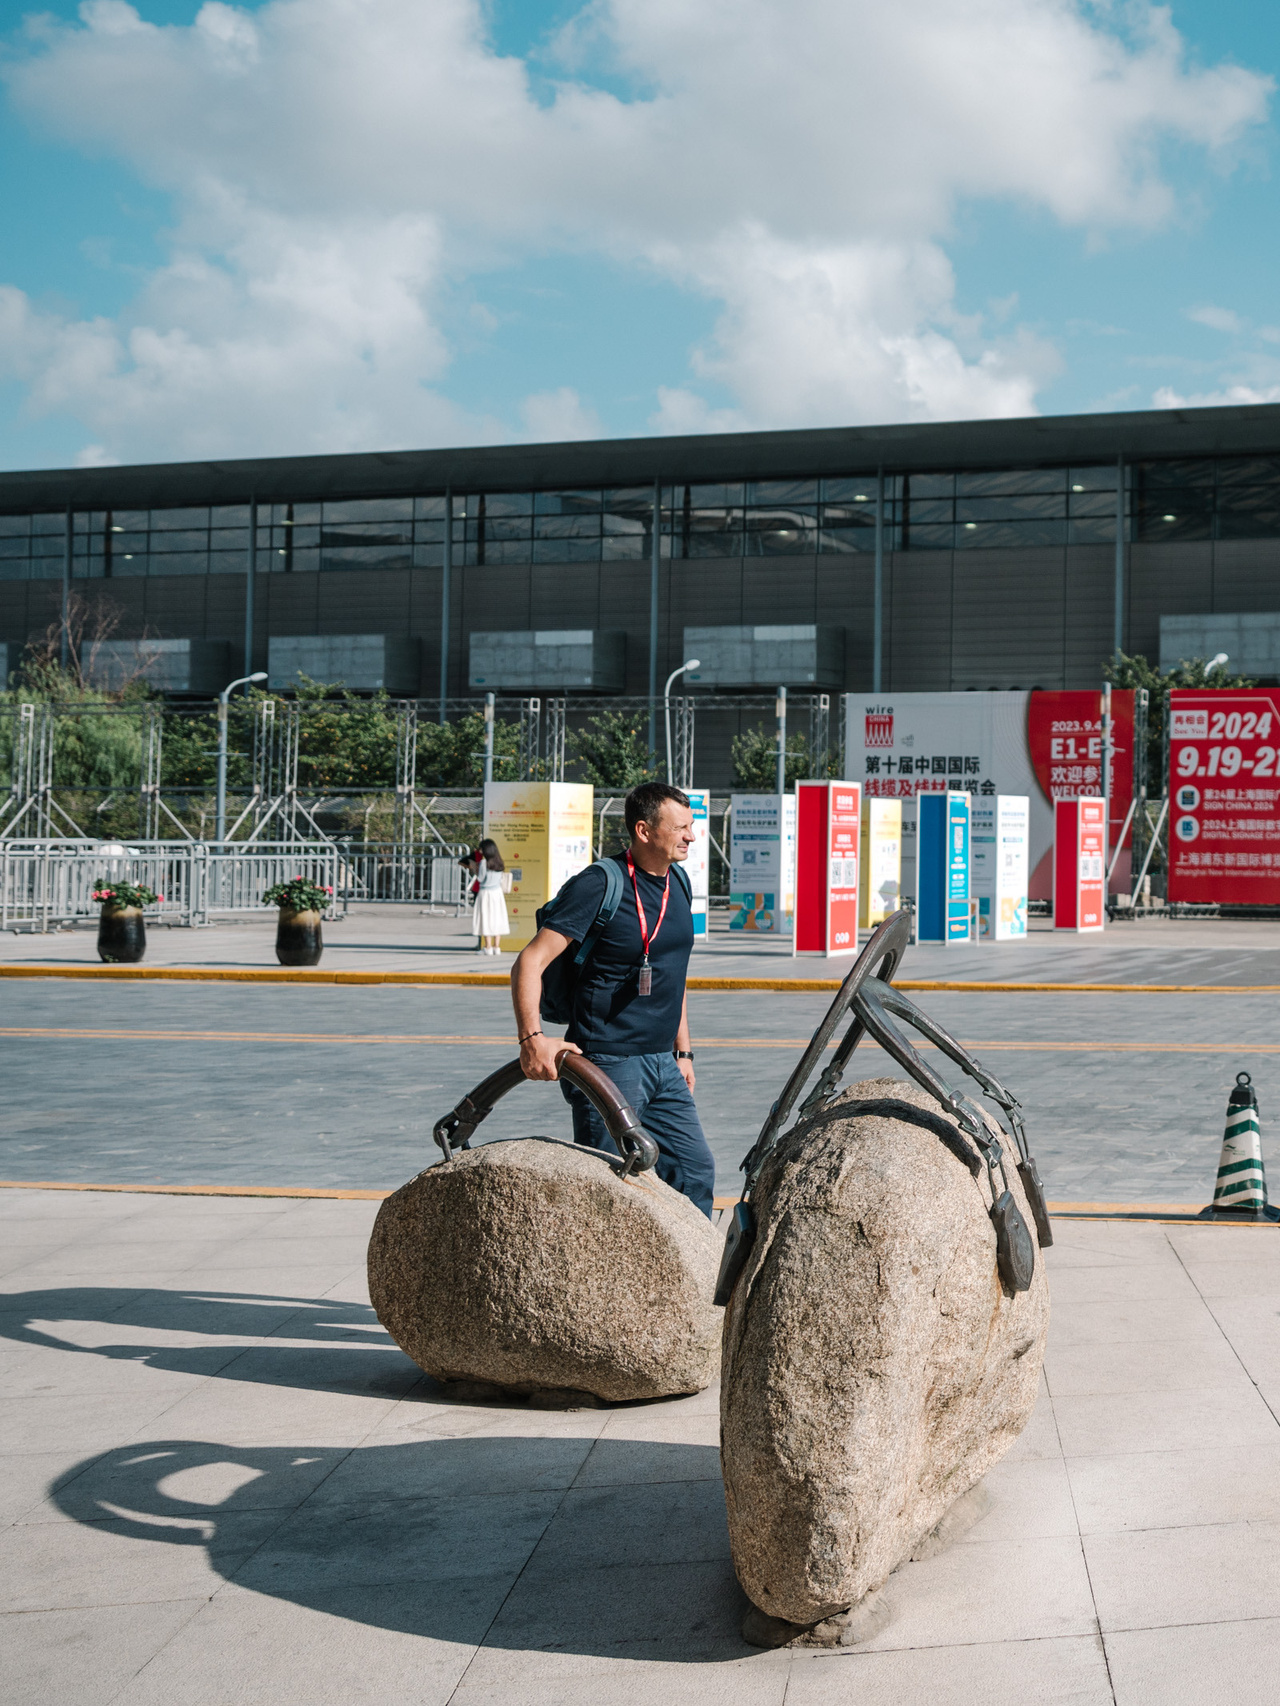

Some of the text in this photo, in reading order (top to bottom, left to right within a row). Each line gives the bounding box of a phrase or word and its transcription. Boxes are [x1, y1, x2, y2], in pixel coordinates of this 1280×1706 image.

[866, 704, 894, 714] wire
[1052, 720, 1115, 732] 2023.9.47
[1208, 711, 1272, 739] 2024
[865, 756, 980, 774] 第十届中国国际
[1203, 802, 1274, 810] SIGN CHINA 2024
